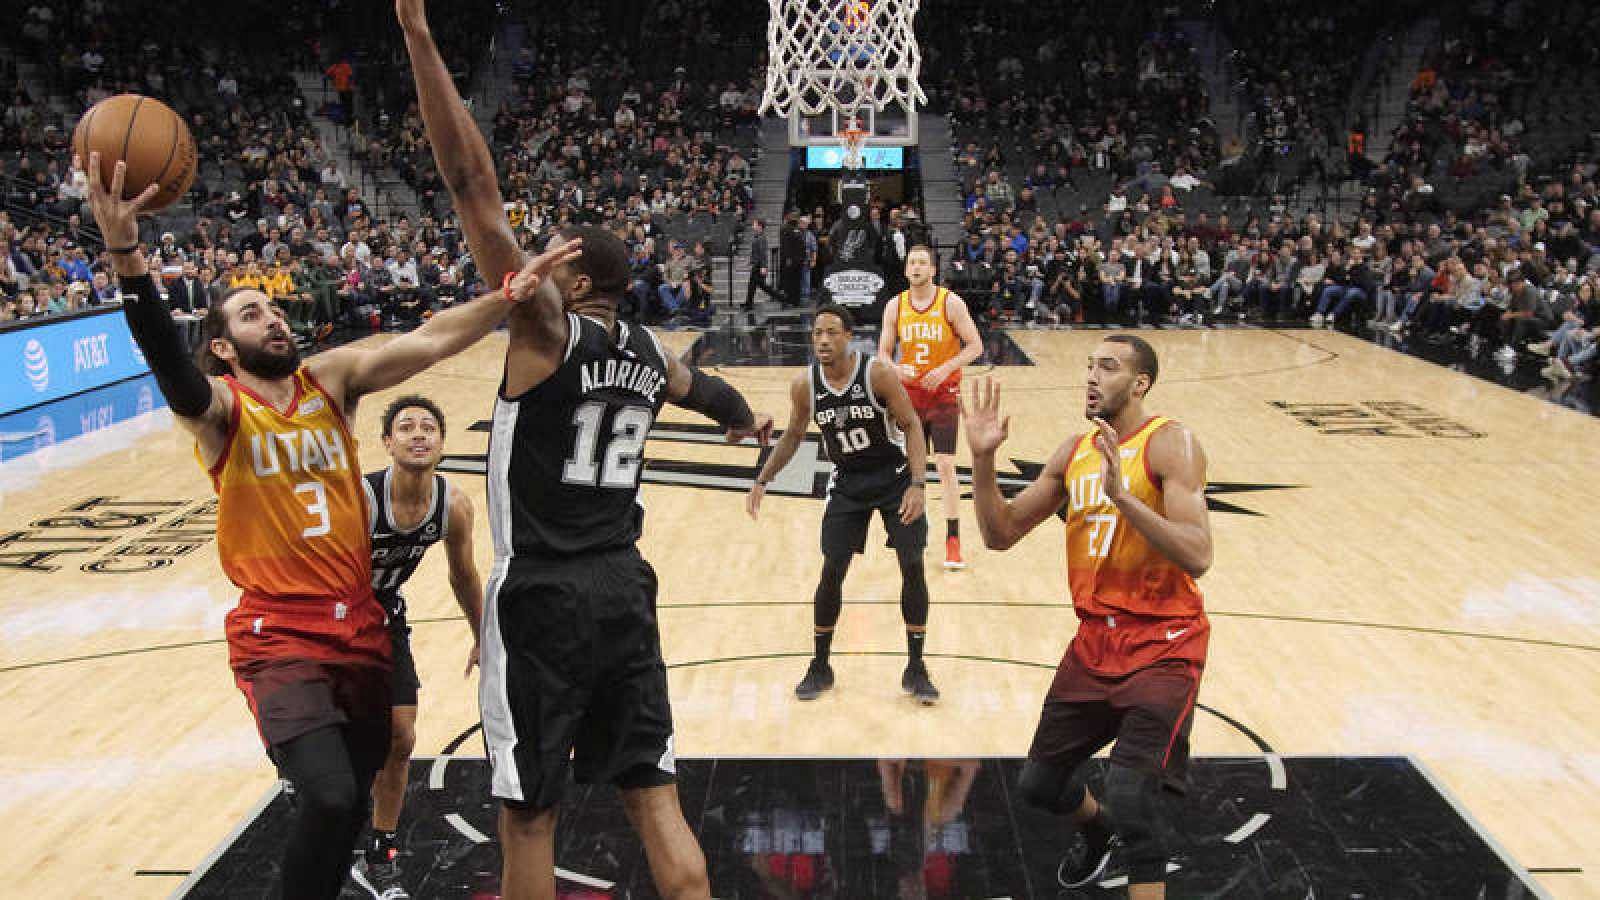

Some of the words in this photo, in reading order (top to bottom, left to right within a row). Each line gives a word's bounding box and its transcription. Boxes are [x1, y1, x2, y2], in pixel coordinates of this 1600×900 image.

[73, 332, 110, 374] AT&T
[902, 322, 944, 342] UTAH
[914, 343, 930, 365] 2
[580, 358, 667, 403] ALDRIDGE
[251, 428, 350, 478] UTAH
[560, 401, 651, 489] 12
[836, 427, 872, 453] 10
[295, 482, 332, 538] 3
[1086, 513, 1118, 558] 27
